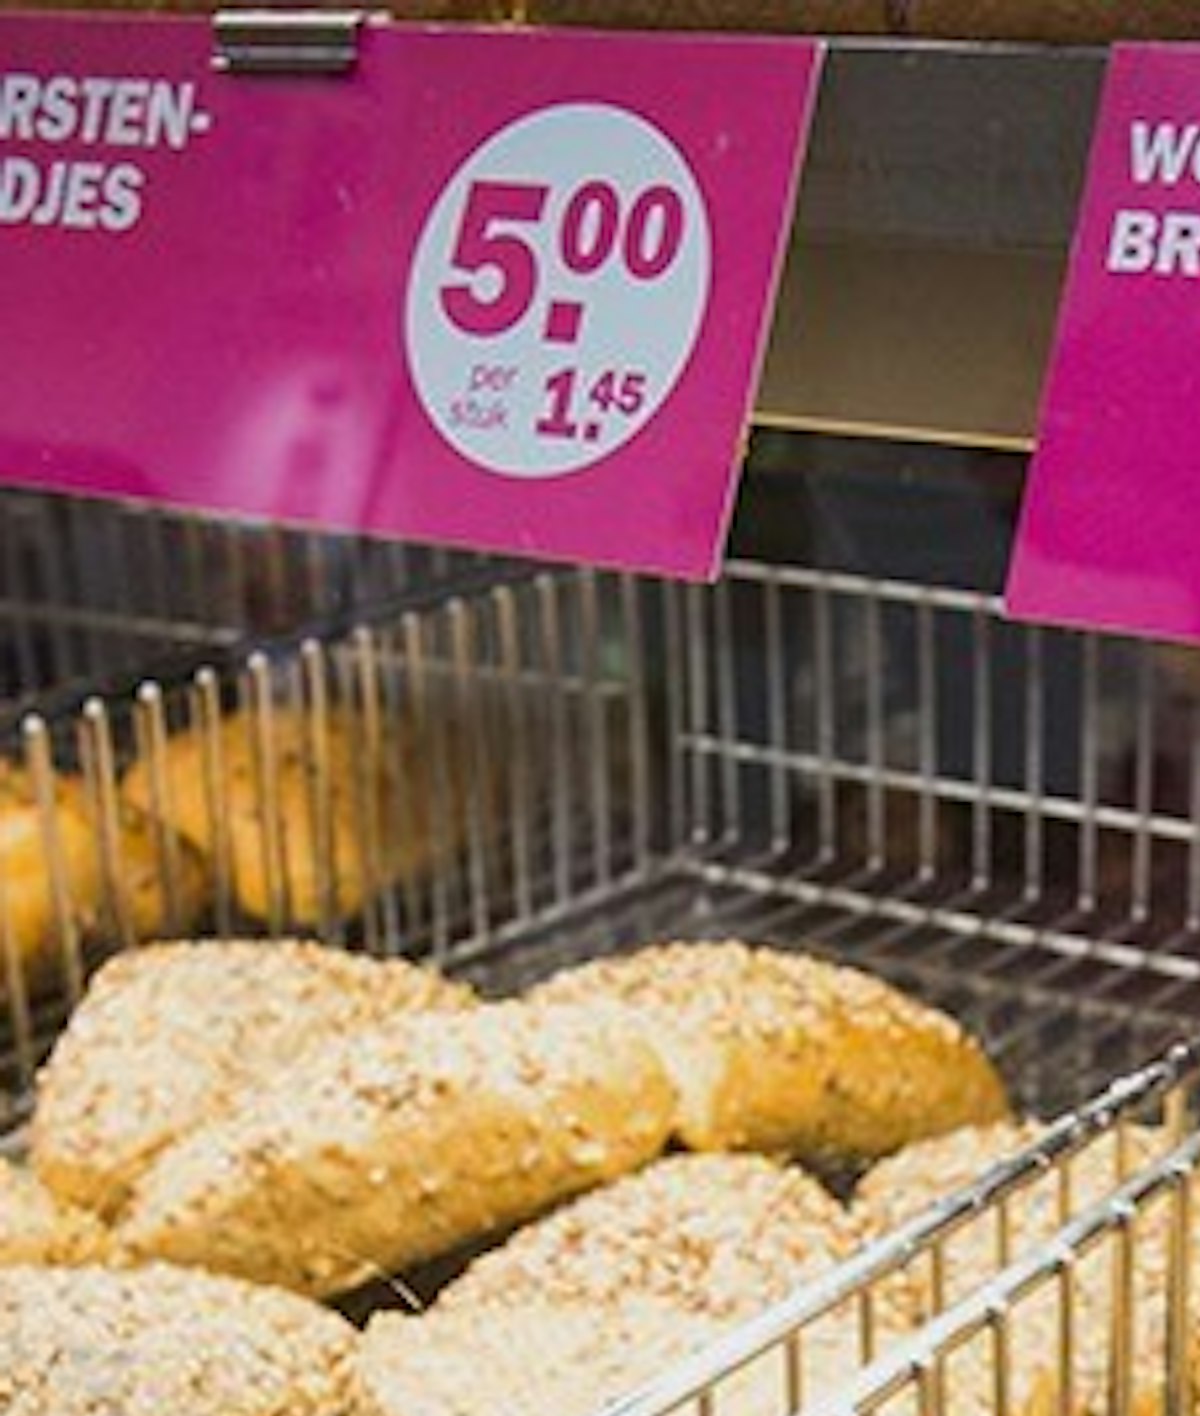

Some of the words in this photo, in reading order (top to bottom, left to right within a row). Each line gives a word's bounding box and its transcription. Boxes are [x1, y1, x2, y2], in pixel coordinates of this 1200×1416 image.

[0, 157, 145, 231] DJES
[438, 180, 684, 343] 5.00
[450, 394, 510, 429] stuk
[469, 364, 518, 392] per
[535, 367, 646, 442] 1.45
